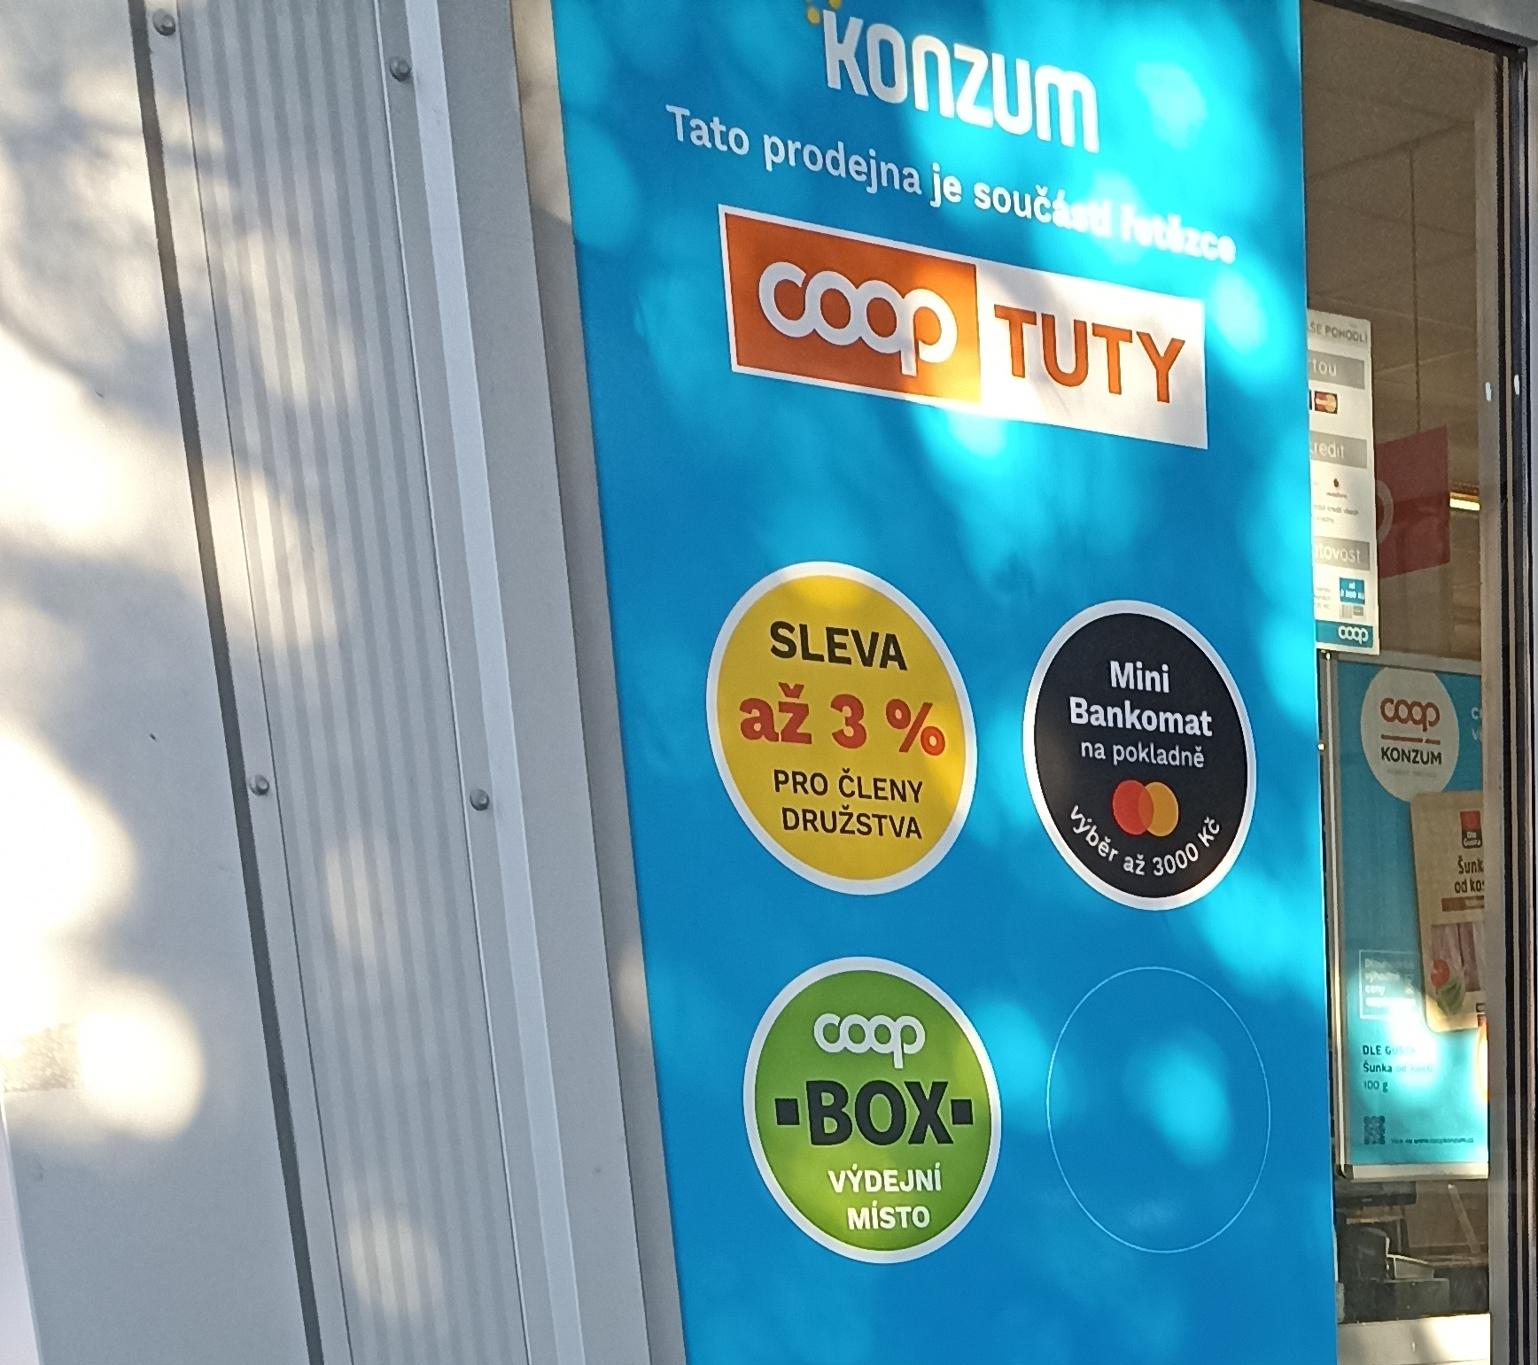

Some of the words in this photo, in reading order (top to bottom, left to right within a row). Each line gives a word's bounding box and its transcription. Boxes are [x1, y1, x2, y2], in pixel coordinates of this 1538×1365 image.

[666, 104, 750, 156] Tato
[763, 131, 922, 197] prodejna
[930, 161, 962, 207] je
[759, 261, 957, 377] coop
[993, 305, 1186, 403] TUTY
[1312, 440, 1345, 459] redit
[769, 620, 908, 670] SLEVA
[1338, 626, 1369, 644] coop
[1109, 660, 1171, 693] Mini
[738, 683, 811, 745] až
[831, 694, 867, 748] 3
[885, 702, 945, 756] %
[1069, 697, 1213, 737] Bankomat
[1380, 697, 1441, 732] coop
[1081, 741, 1107, 762] na
[1112, 739, 1205, 770] pokladně
[1381, 746, 1442, 765] KONZUM
[773, 768, 829, 797] PRO
[838, 768, 923, 804] ČLENY
[781, 804, 923, 840] DRUŽSTVA
[1070, 804, 1119, 862] výběr
[1123, 854, 1146, 876] až
[1153, 842, 1199, 876] 3000
[1197, 816, 1220, 848] Kč
[814, 1014, 925, 1068] coop
[1362, 1045, 1382, 1055] DLE
[1363, 1060, 1392, 1073] Šunka
[828, 1163, 942, 1195] VÝDEJNÍ
[847, 1201, 930, 1231] MÍSTO
